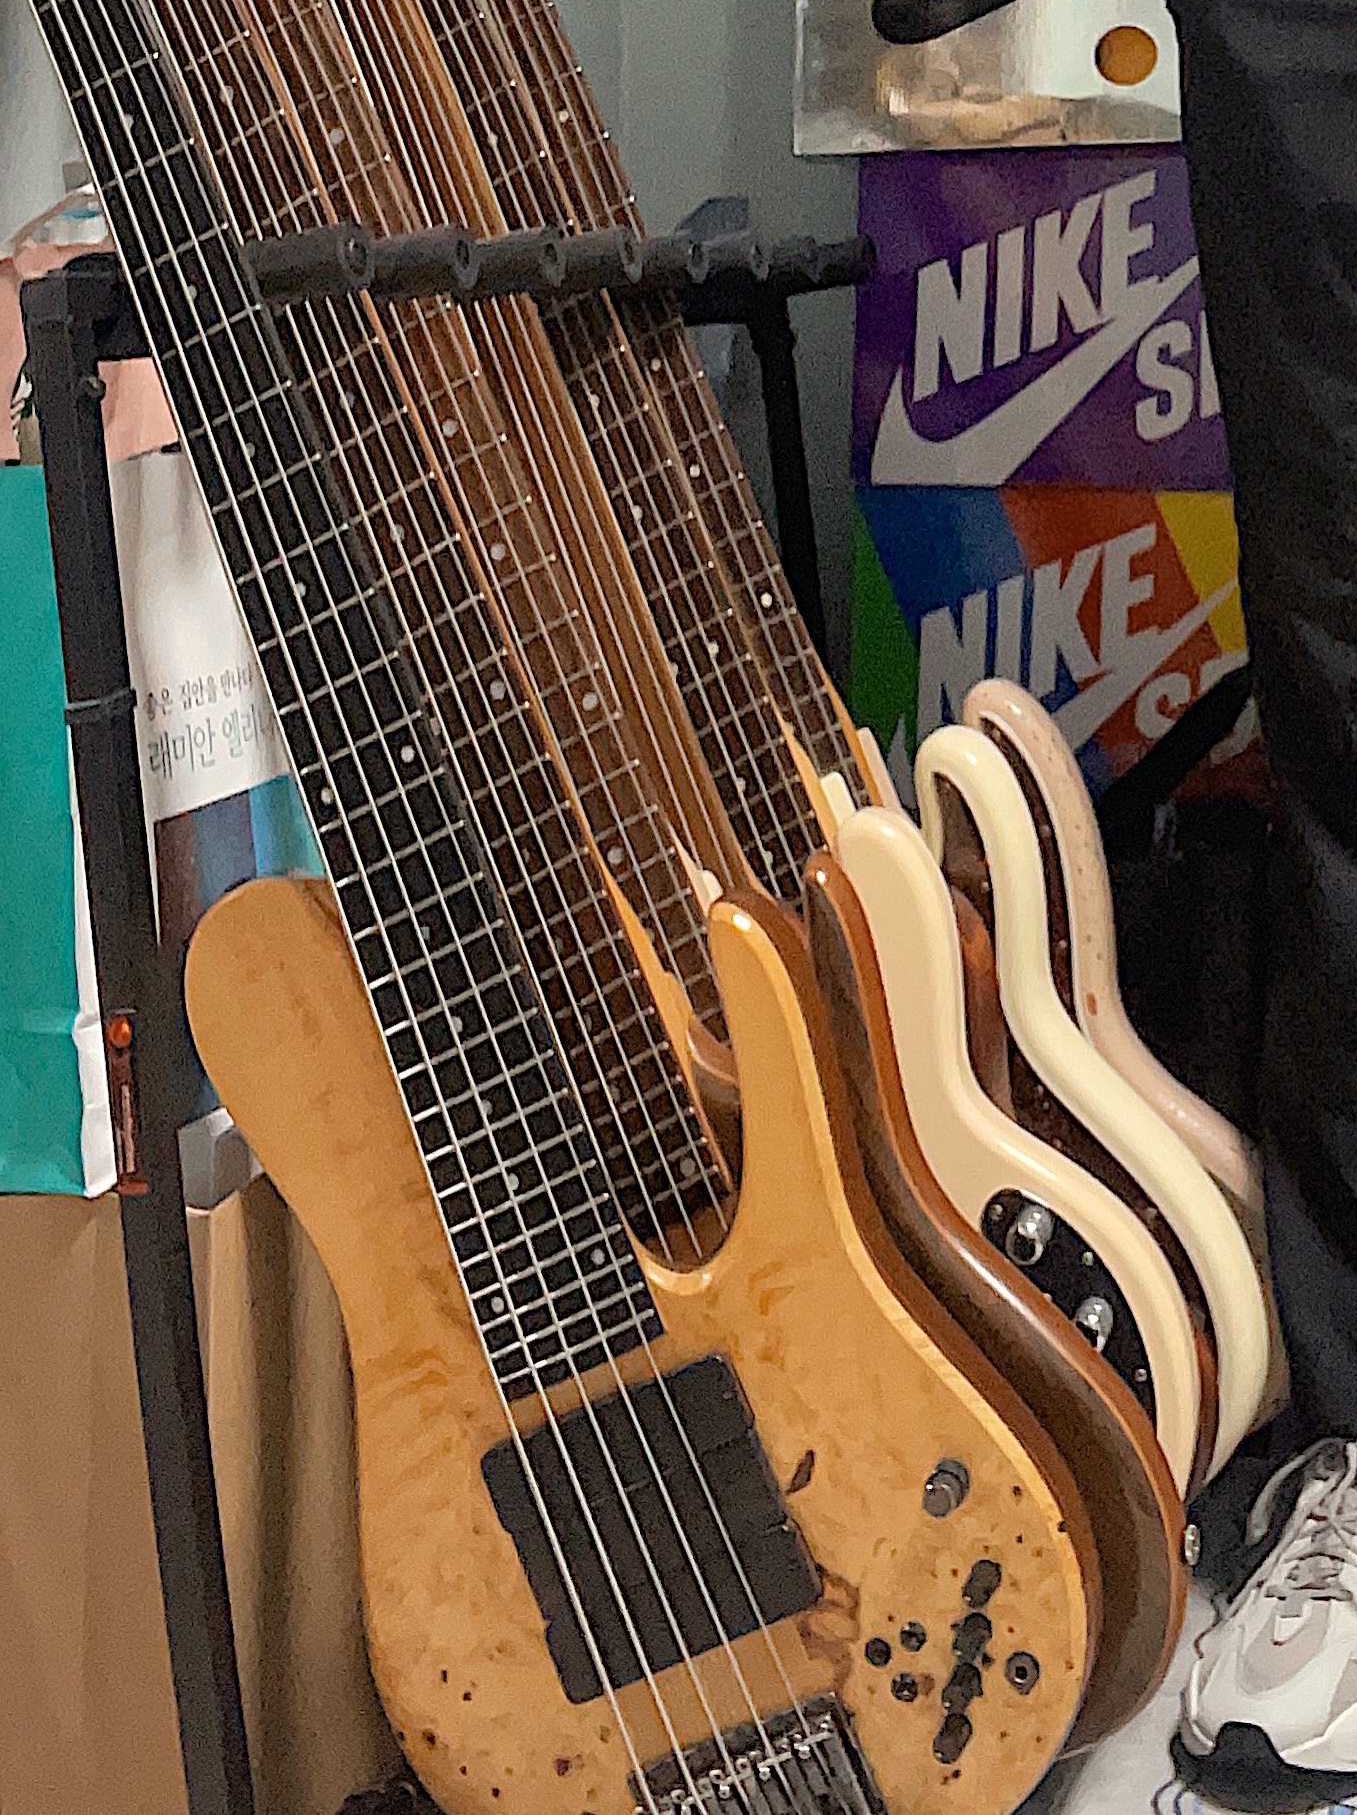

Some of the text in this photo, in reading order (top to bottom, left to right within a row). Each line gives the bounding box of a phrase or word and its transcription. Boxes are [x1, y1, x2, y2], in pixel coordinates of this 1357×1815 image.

[914, 168, 1160, 403] NIKE
[1136, 308, 1221, 443] S
[918, 522, 1158, 744] NIKE
[147, 717, 217, 780] 래미안
